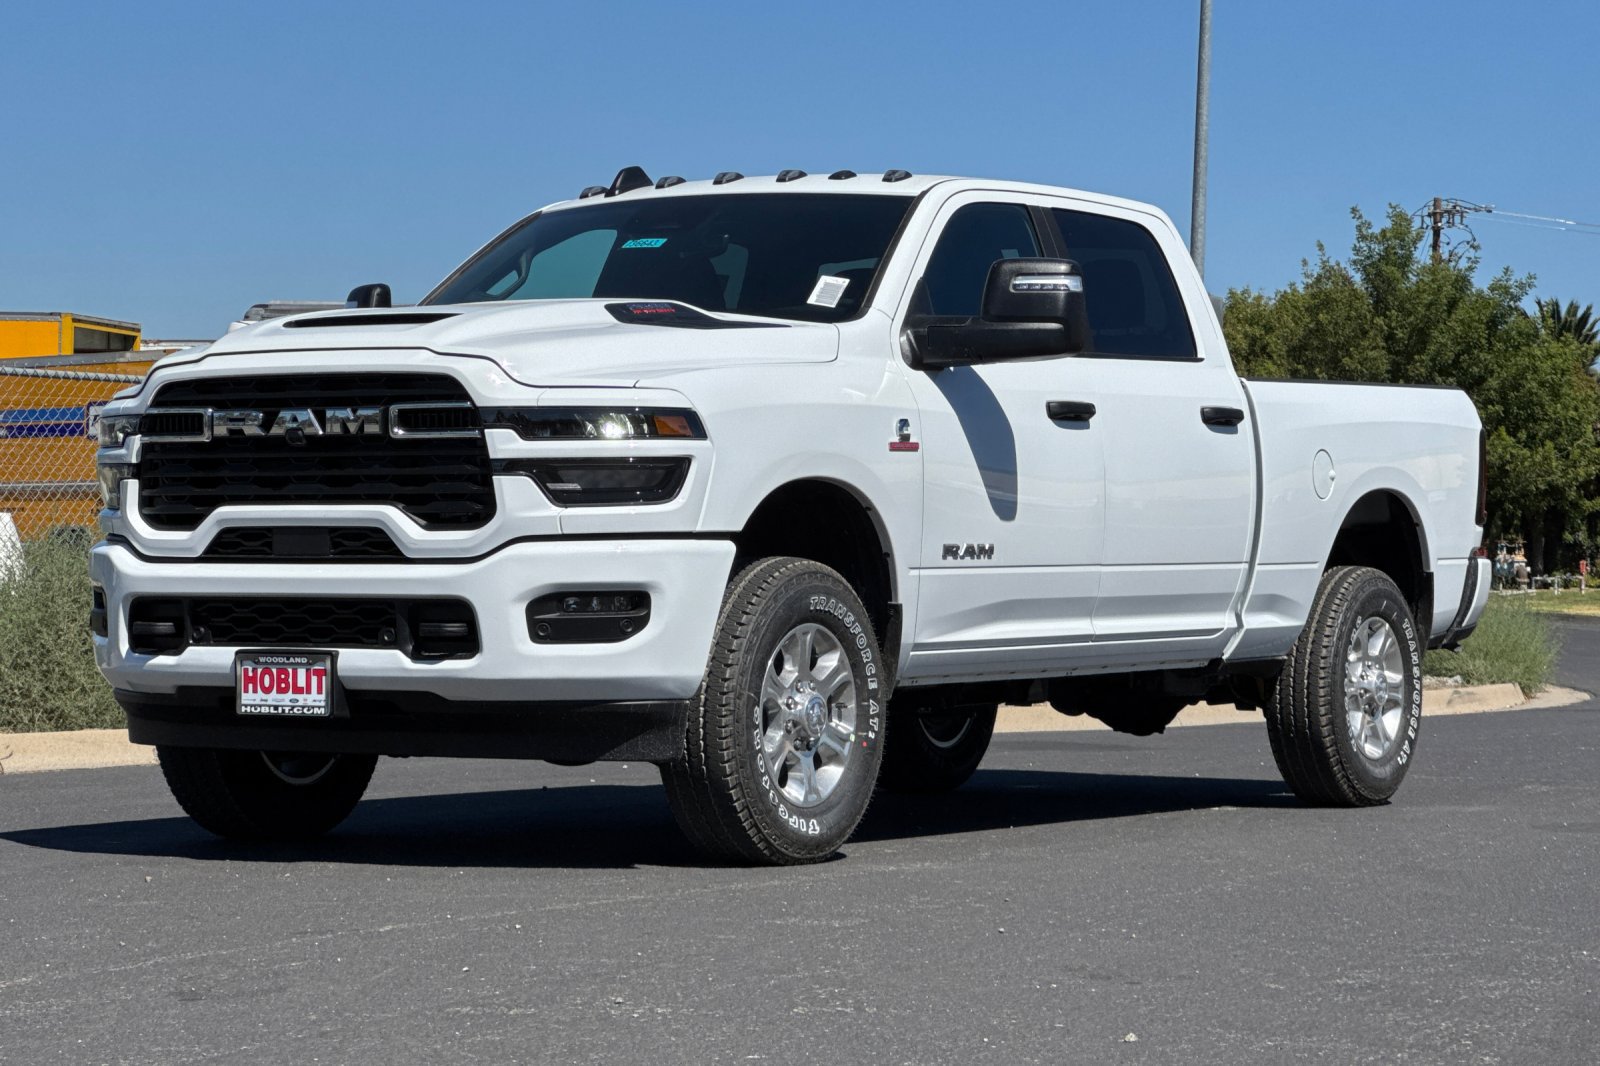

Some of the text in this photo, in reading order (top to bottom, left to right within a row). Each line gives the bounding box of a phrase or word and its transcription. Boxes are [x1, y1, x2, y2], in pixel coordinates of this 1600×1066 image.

[212, 407, 388, 436] RAM
[942, 543, 994, 560] RAM
[810, 596, 878, 690] TRANSFORCE
[258, 656, 308, 664] WOODLAND
[242, 666, 327, 695] HOBLIT
[1402, 618, 1420, 740] TRANSFORCE
[241, 705, 325, 715] HOBLIT.COM
